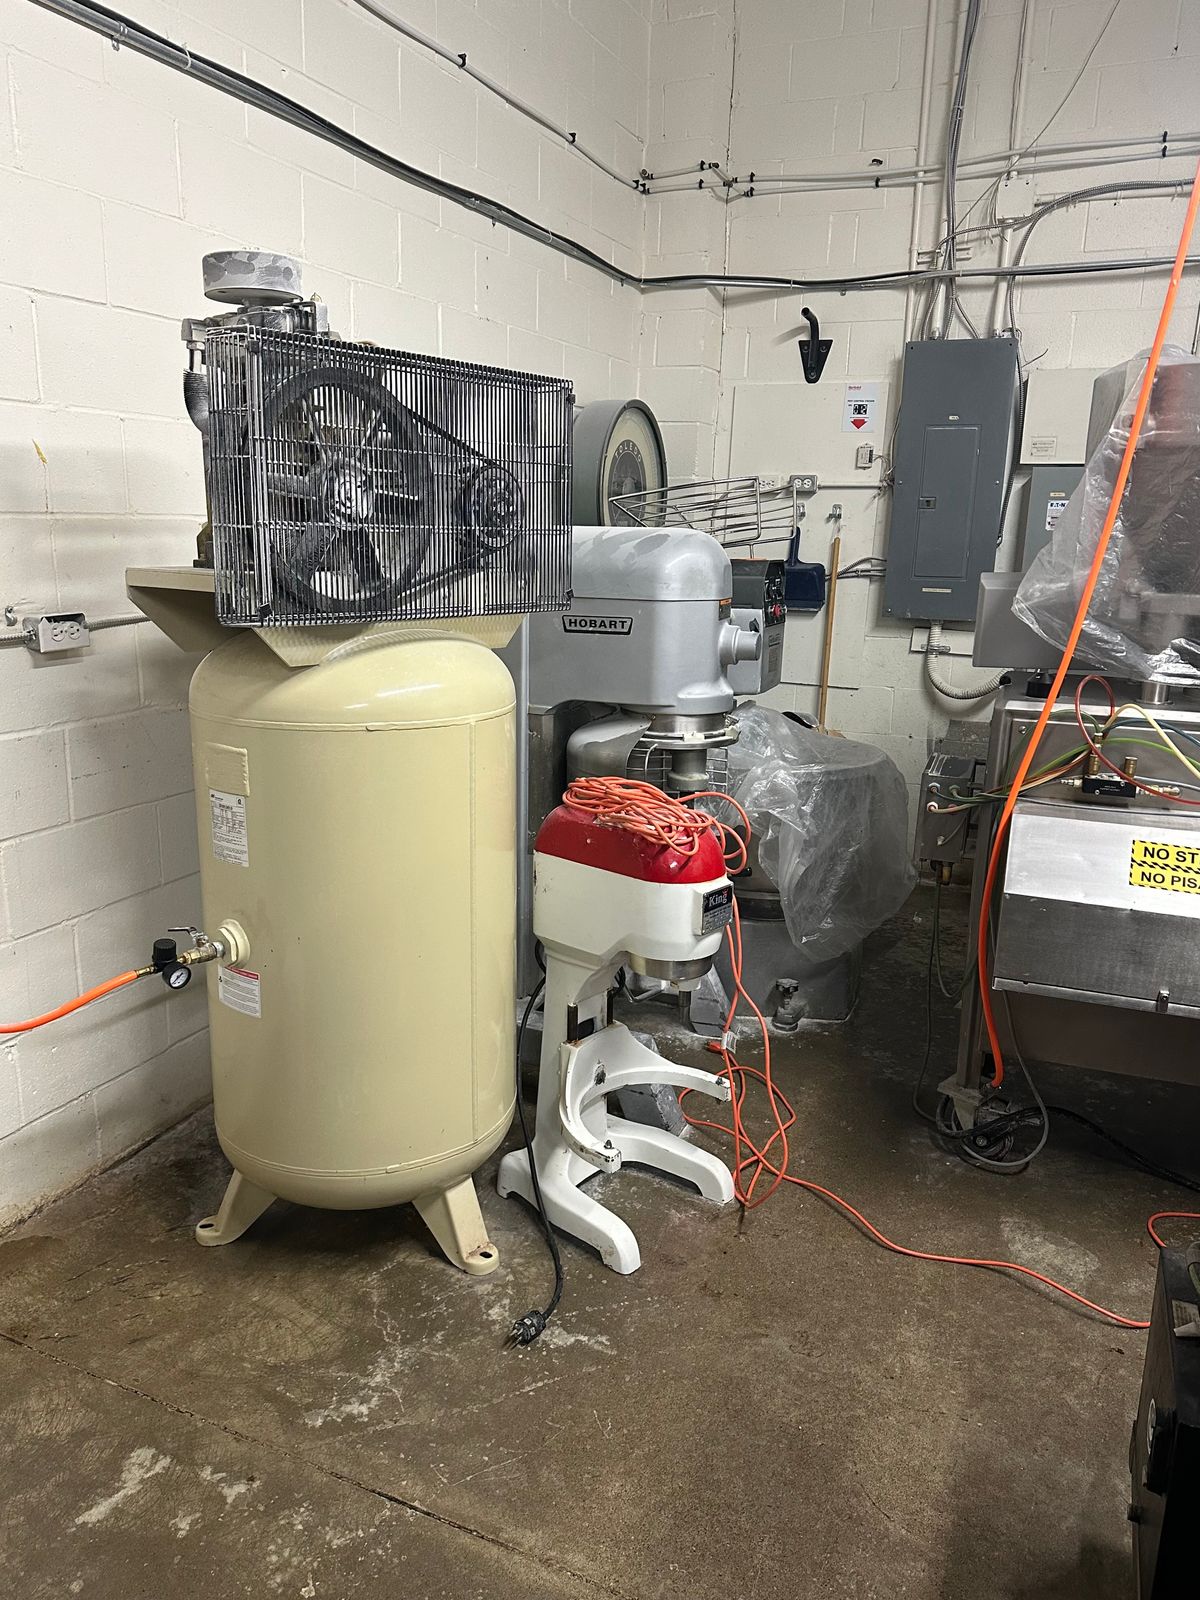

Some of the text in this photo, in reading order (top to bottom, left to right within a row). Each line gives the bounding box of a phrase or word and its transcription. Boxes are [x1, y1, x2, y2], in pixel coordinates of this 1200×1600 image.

[615, 441, 641, 462] TOLEDO
[568, 618, 628, 630] HOBART
[1143, 846, 1200, 864] NO ST
[1140, 871, 1165, 884] NO
[709, 894, 728, 907] King
